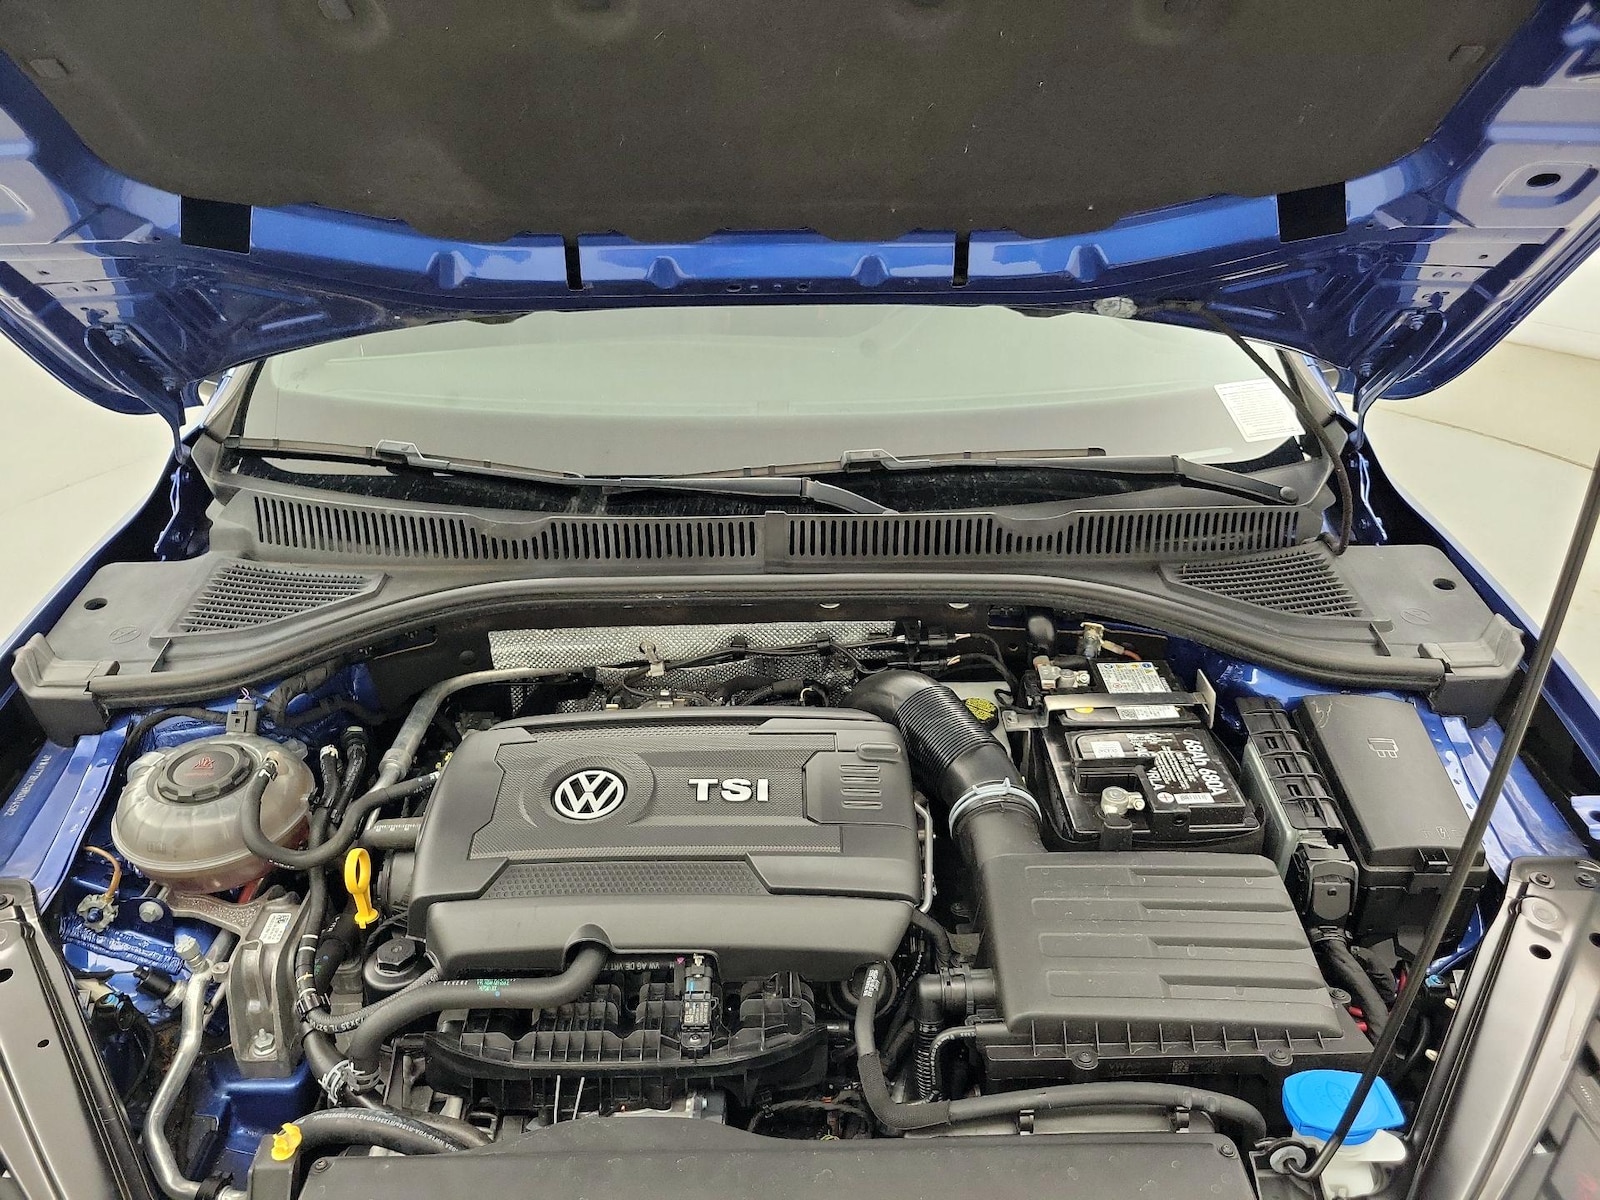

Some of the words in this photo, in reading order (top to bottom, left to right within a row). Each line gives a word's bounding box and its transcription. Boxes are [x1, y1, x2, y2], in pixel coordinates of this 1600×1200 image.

[688, 778, 770, 803] TSI
[1183, 739, 1210, 766] 68Ah
[1198, 768, 1228, 796] 680A
[551, 768, 625, 820] VW
